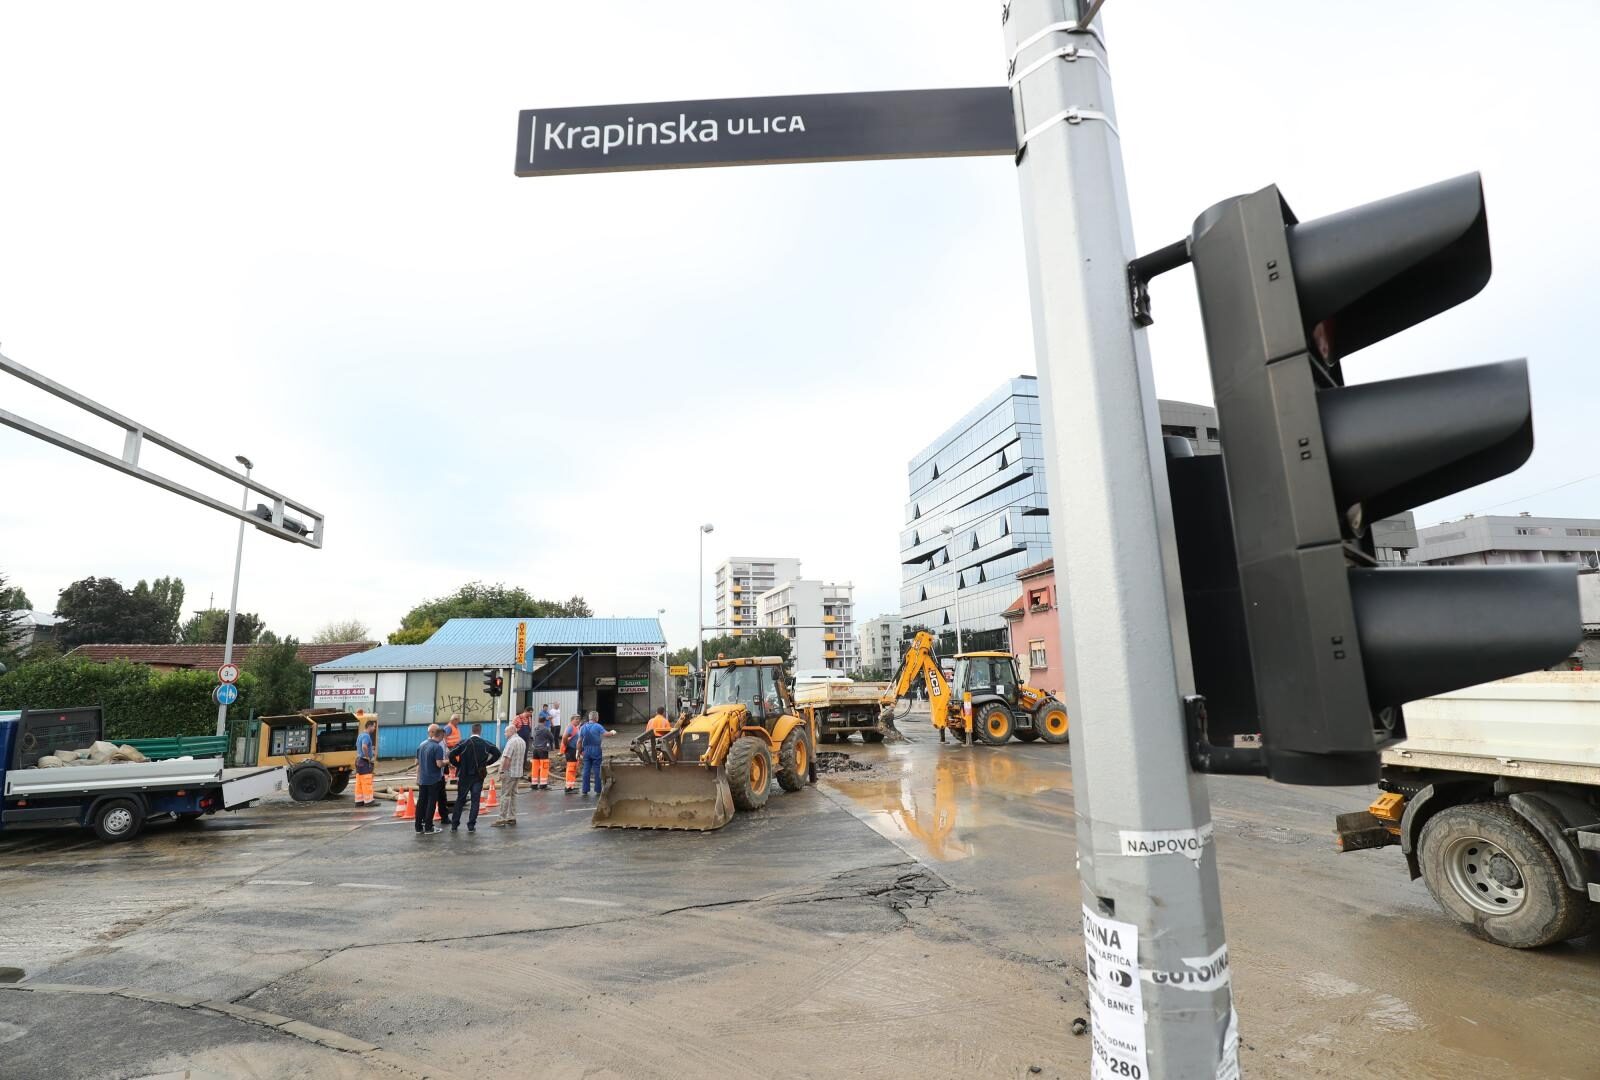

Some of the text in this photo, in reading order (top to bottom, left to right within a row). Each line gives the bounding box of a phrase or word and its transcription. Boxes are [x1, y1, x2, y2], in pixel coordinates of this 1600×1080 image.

[544, 113, 805, 154] Krapinska ULICA
[928, 669, 941, 697] JCB
[1022, 689, 1038, 699] JCB
[1107, 998, 1136, 1016] BANKE
[1110, 1057, 1142, 1080] 280
